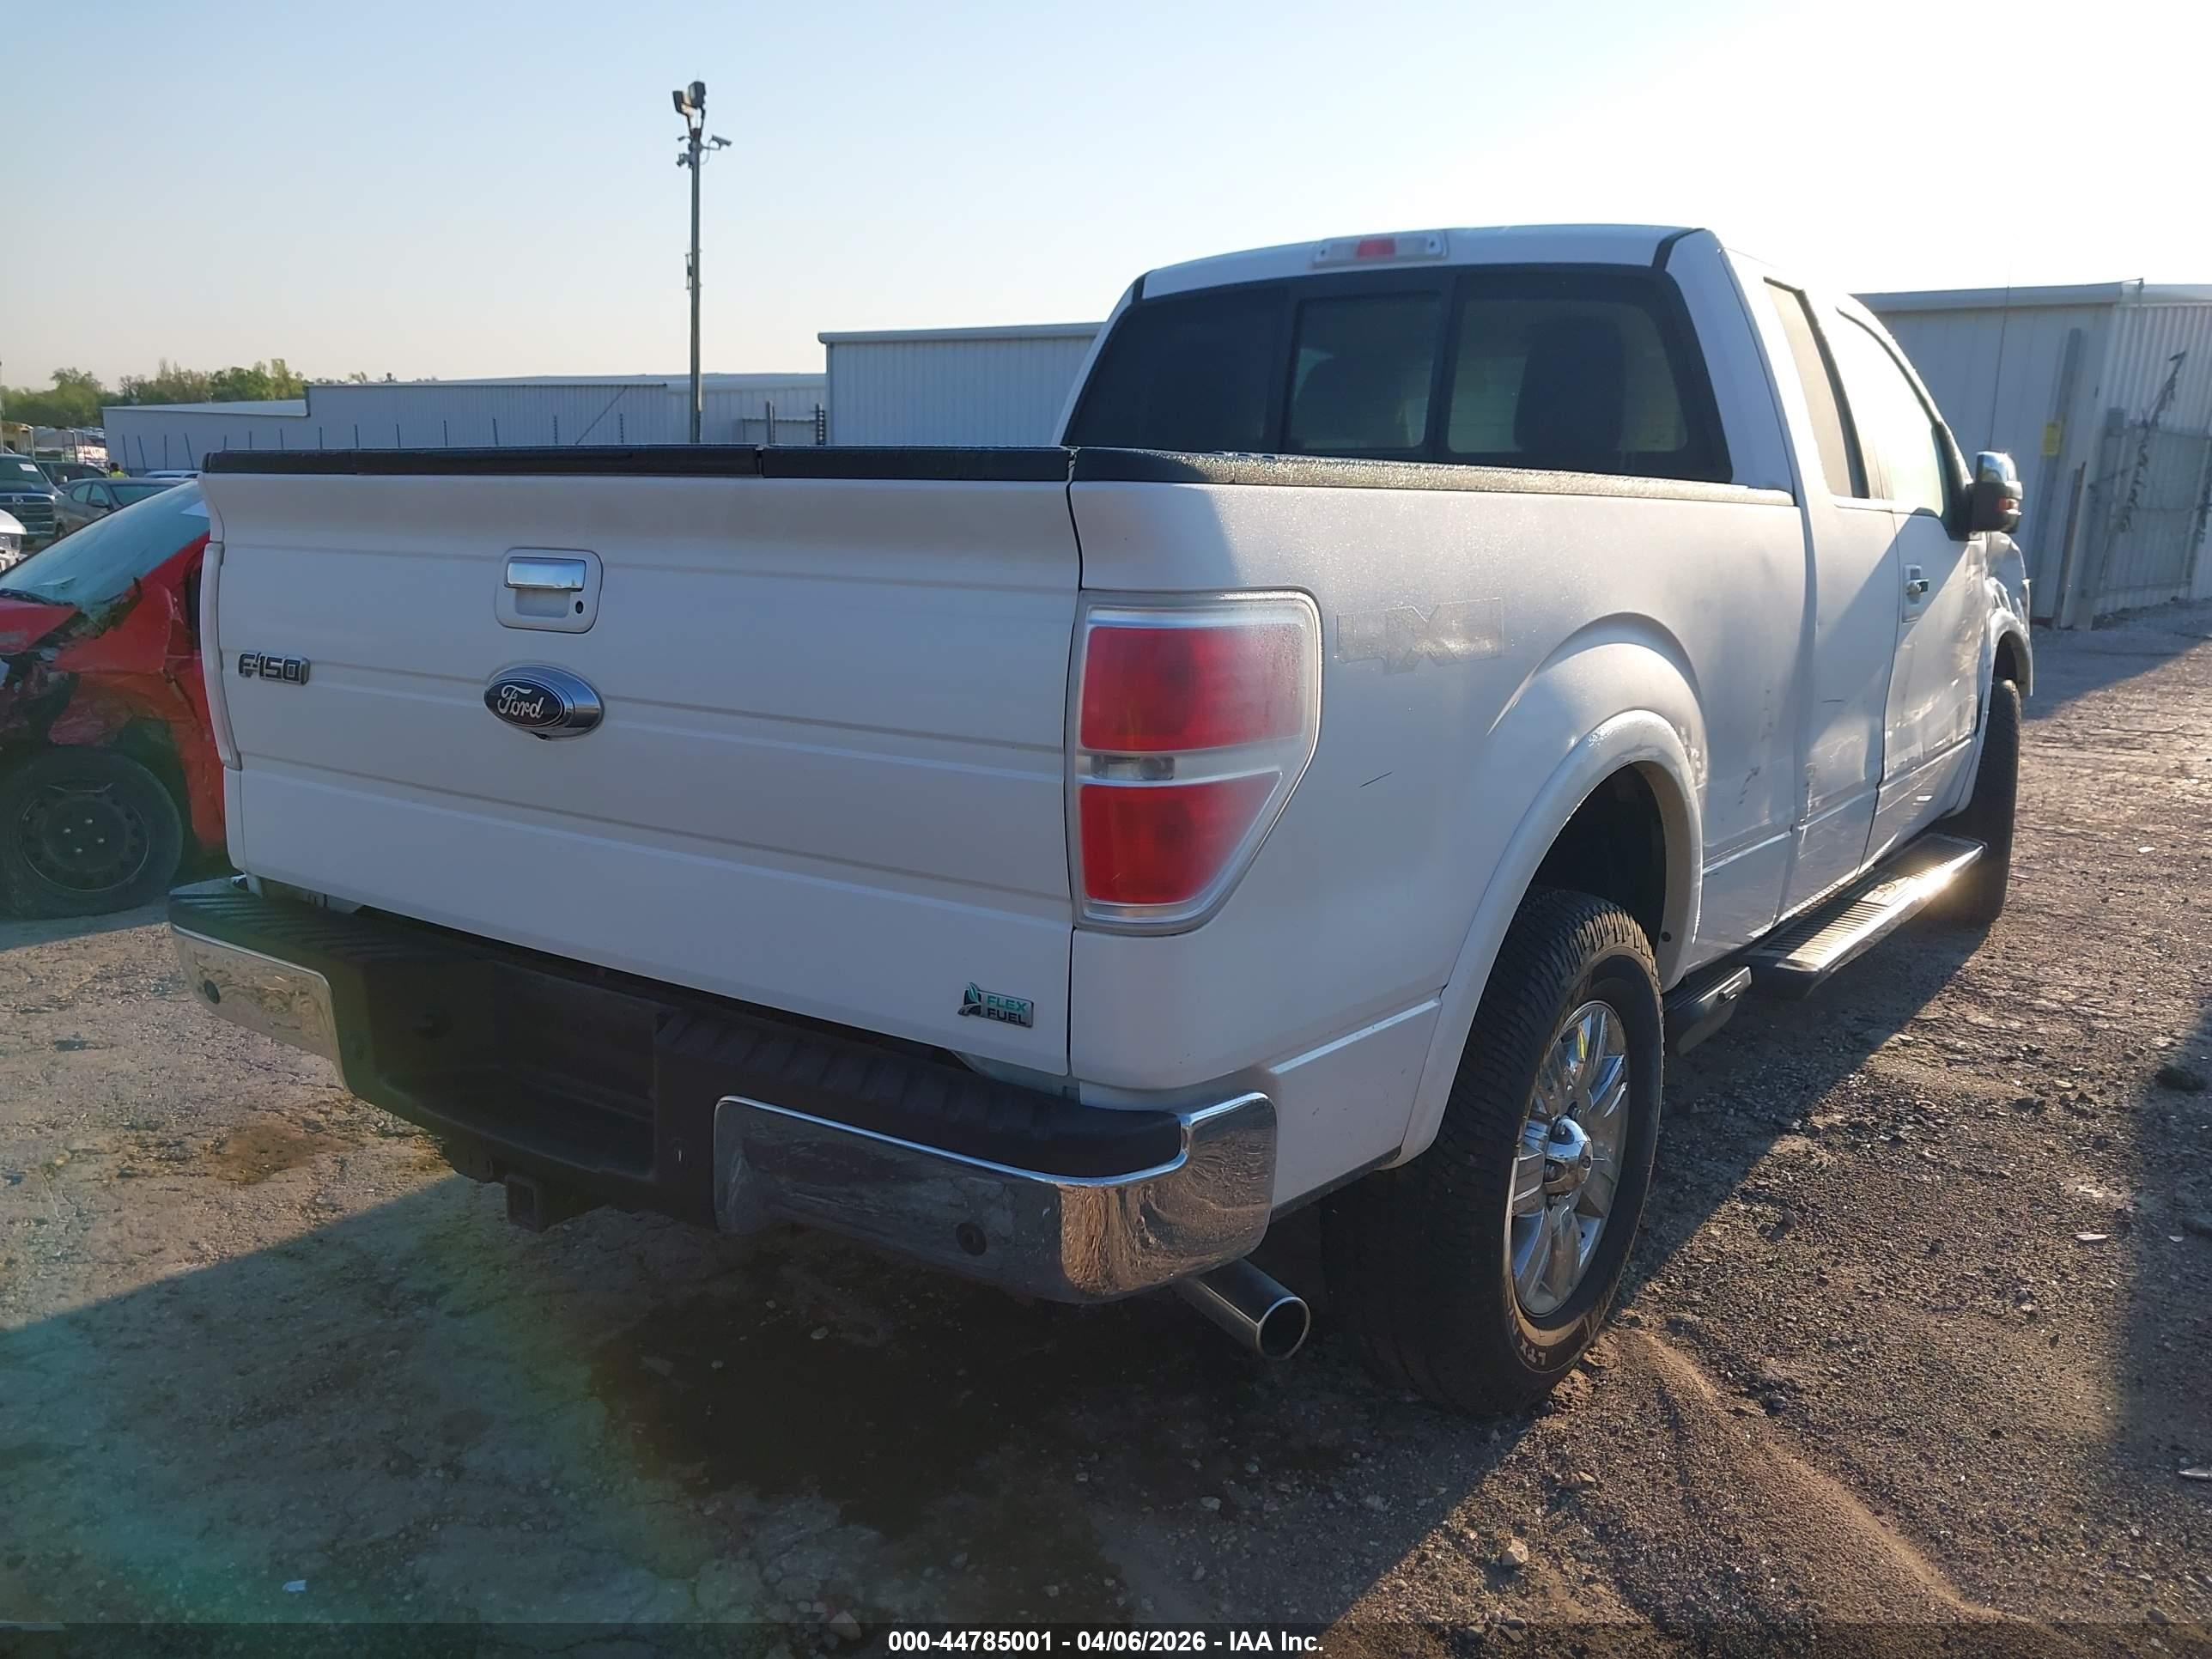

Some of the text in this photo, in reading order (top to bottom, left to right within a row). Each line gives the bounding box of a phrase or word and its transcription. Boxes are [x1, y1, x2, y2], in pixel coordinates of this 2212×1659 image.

[496, 684, 546, 719] Ford
[987, 995, 1027, 1012] FLEX
[987, 1007, 1027, 1025] FUEL
